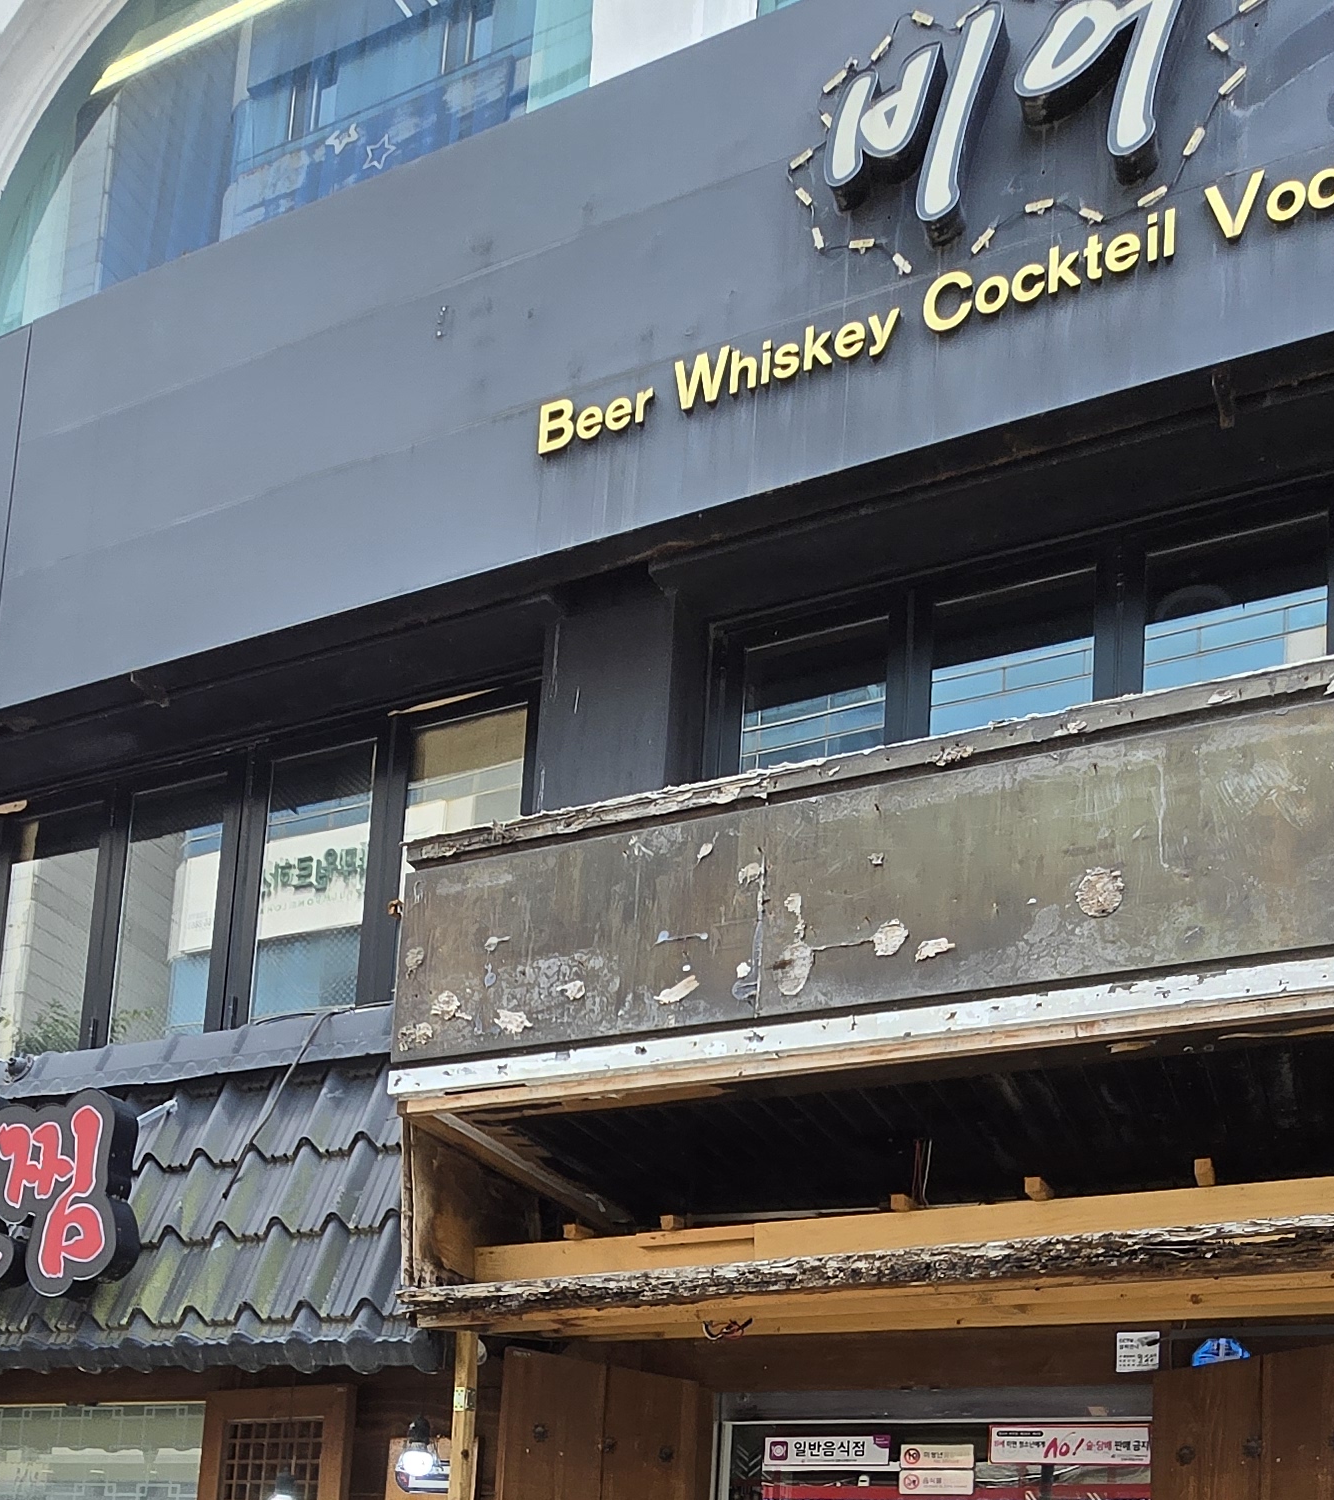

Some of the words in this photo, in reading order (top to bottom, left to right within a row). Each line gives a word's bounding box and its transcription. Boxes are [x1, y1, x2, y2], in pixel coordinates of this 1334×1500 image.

[537, 384, 653, 456] Beer
[673, 307, 900, 412] Whiskey
[922, 209, 1177, 332] Cockteil
[794, 1440, 866, 1457] 일반음식점
